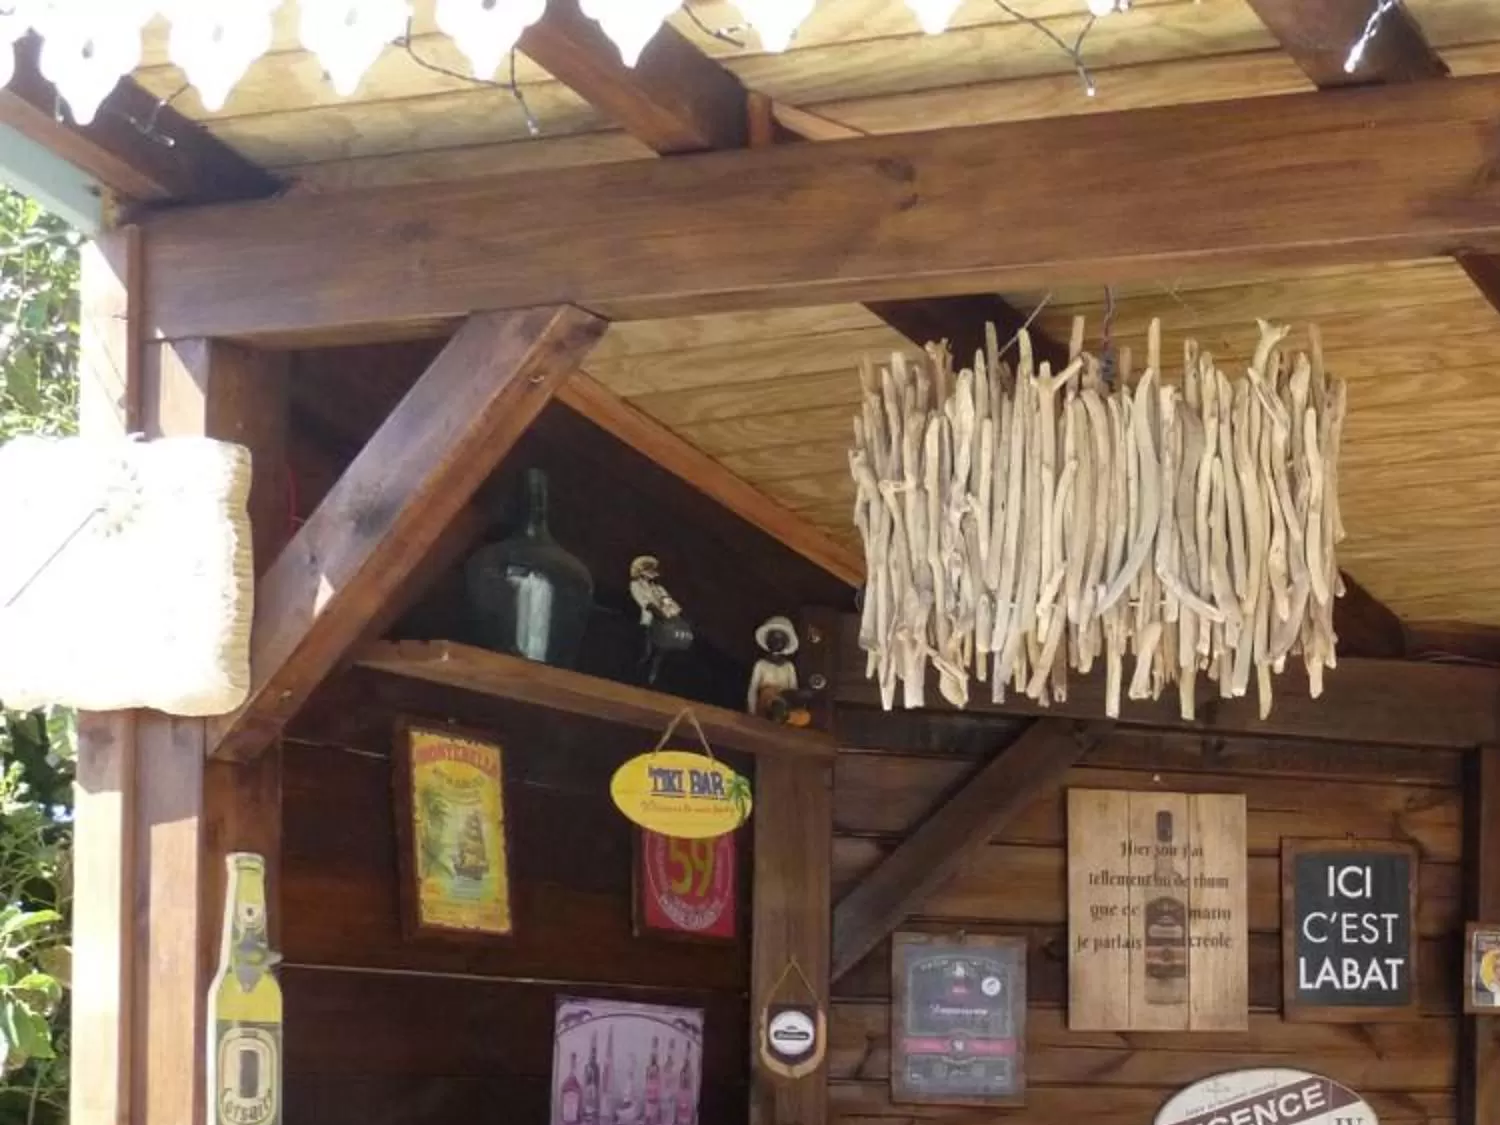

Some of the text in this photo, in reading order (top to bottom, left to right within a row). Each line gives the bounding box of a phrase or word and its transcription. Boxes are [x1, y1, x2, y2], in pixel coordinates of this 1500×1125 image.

[648, 766, 725, 796] TIKI BAR
[1088, 869, 1151, 888] tellement
[1193, 872, 1230, 889] rhum
[1327, 865, 1373, 899] ICI
[1302, 911, 1400, 945] C'EST
[1299, 956, 1405, 991] LABAT
